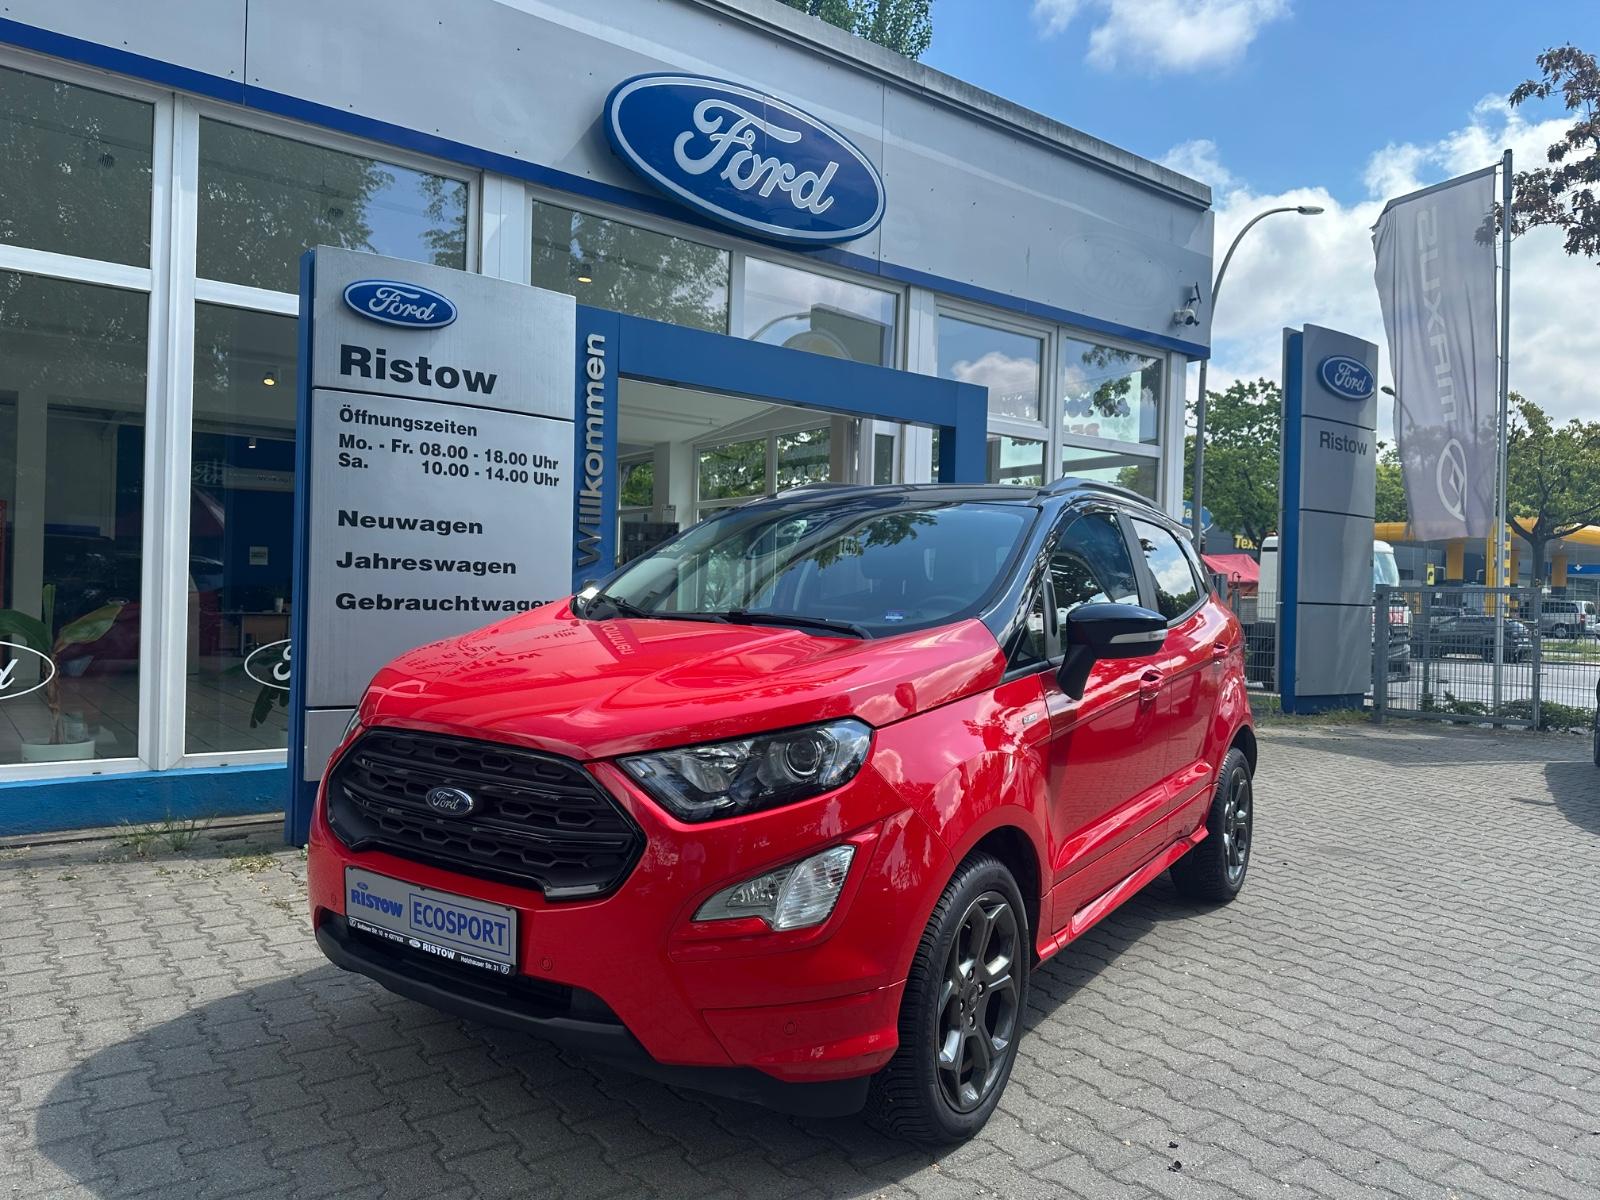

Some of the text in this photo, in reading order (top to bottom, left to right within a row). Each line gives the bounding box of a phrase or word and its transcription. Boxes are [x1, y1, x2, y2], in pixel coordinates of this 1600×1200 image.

[674, 98, 840, 215] Ford
[368, 287, 437, 322] Ford
[340, 344, 498, 395] Ristow
[1332, 362, 1367, 394] Ford
[338, 404, 478, 437] Öffnungszeiten
[338, 433, 373, 451] Mo.
[391, 438, 414, 455] Fr.
[419, 442, 469, 460] 08.00
[484, 449, 528, 467] 18.00
[532, 454, 559, 471] Uhr
[575, 332, 606, 568] Willkommen
[1319, 430, 1368, 456] Ristow
[338, 453, 369, 470] Sa.
[421, 460, 470, 478] 10.00
[485, 468, 529, 484] 14.00
[532, 472, 560, 488] Uhr
[337, 509, 484, 535] Neuwagen
[336, 551, 517, 576] Jahreswagen
[432, 790, 461, 810] Ford
[350, 888, 404, 918] RISTOW
[413, 901, 506, 946] ECOSPORT
[422, 942, 455, 960] RISTOW
